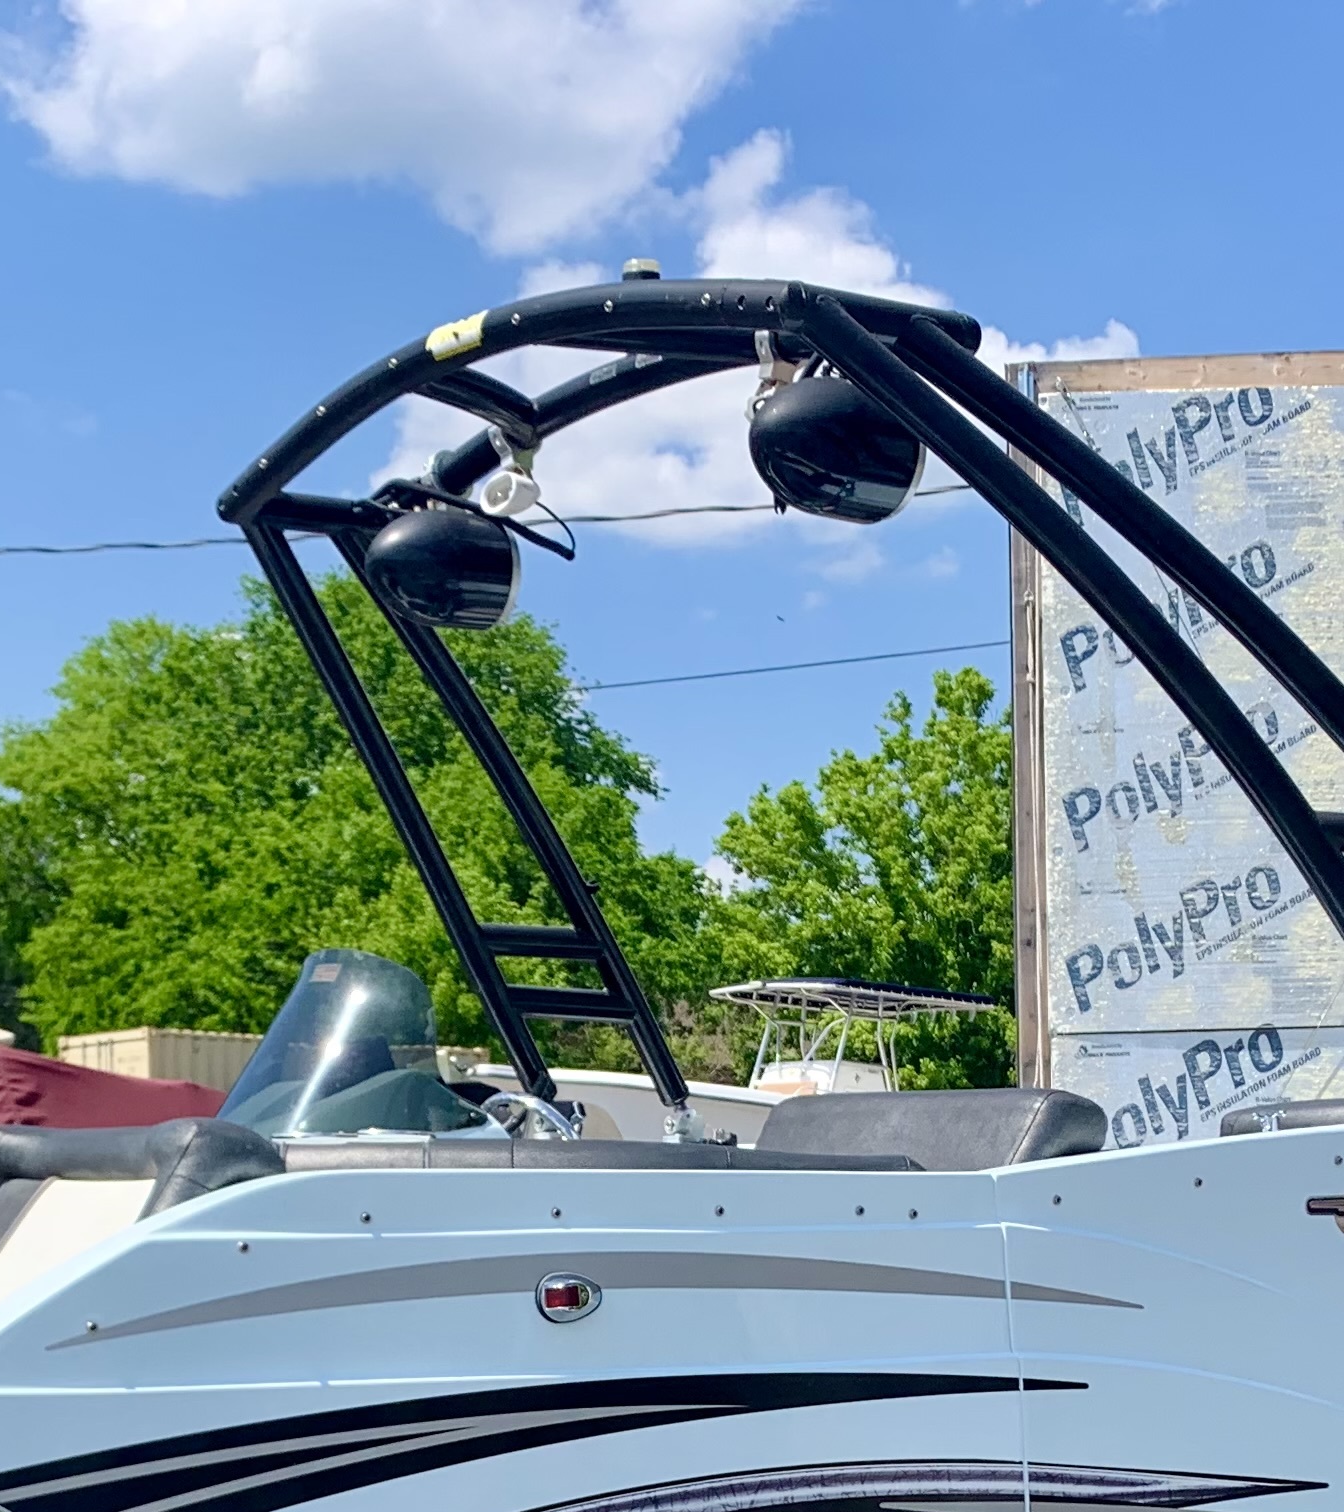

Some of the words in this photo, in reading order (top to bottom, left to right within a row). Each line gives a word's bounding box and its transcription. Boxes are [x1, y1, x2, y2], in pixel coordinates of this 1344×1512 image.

[1065, 863, 1281, 1014] PolyPro
[1196, 944, 1212, 960] EPS
[1111, 1023, 1284, 1150] olyPro
[1200, 1106, 1216, 1122] EPS
[1216, 1078, 1265, 1112] INSULATION
[1267, 1063, 1290, 1083] FOAM
[1291, 1046, 1320, 1069] BOARD
